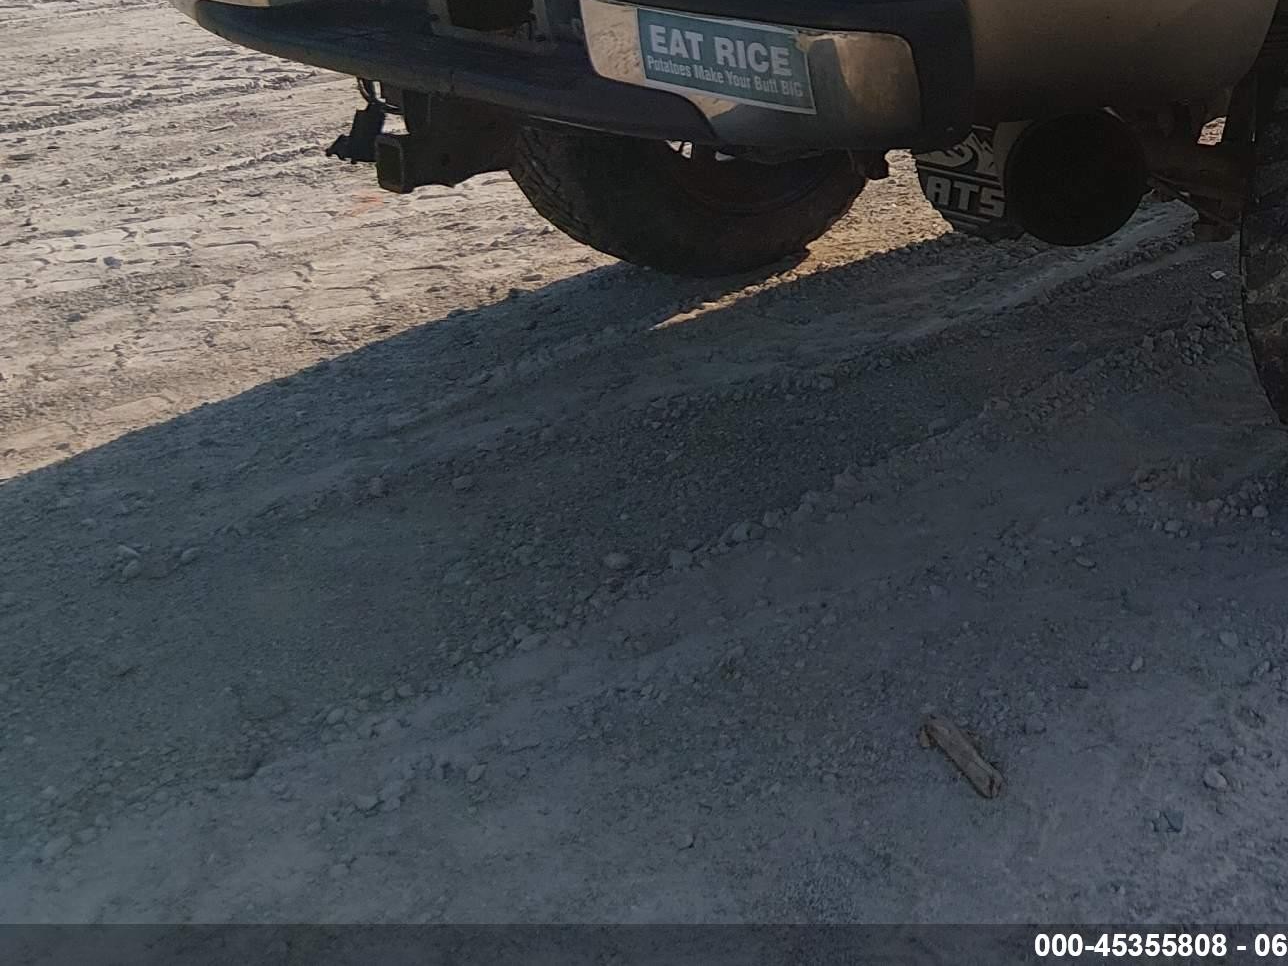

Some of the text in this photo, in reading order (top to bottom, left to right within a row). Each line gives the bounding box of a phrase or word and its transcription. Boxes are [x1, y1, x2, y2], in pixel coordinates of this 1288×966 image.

[649, 24, 793, 76] EAT RICE
[646, 54, 804, 98] Potatoes Make Your Butt BIG
